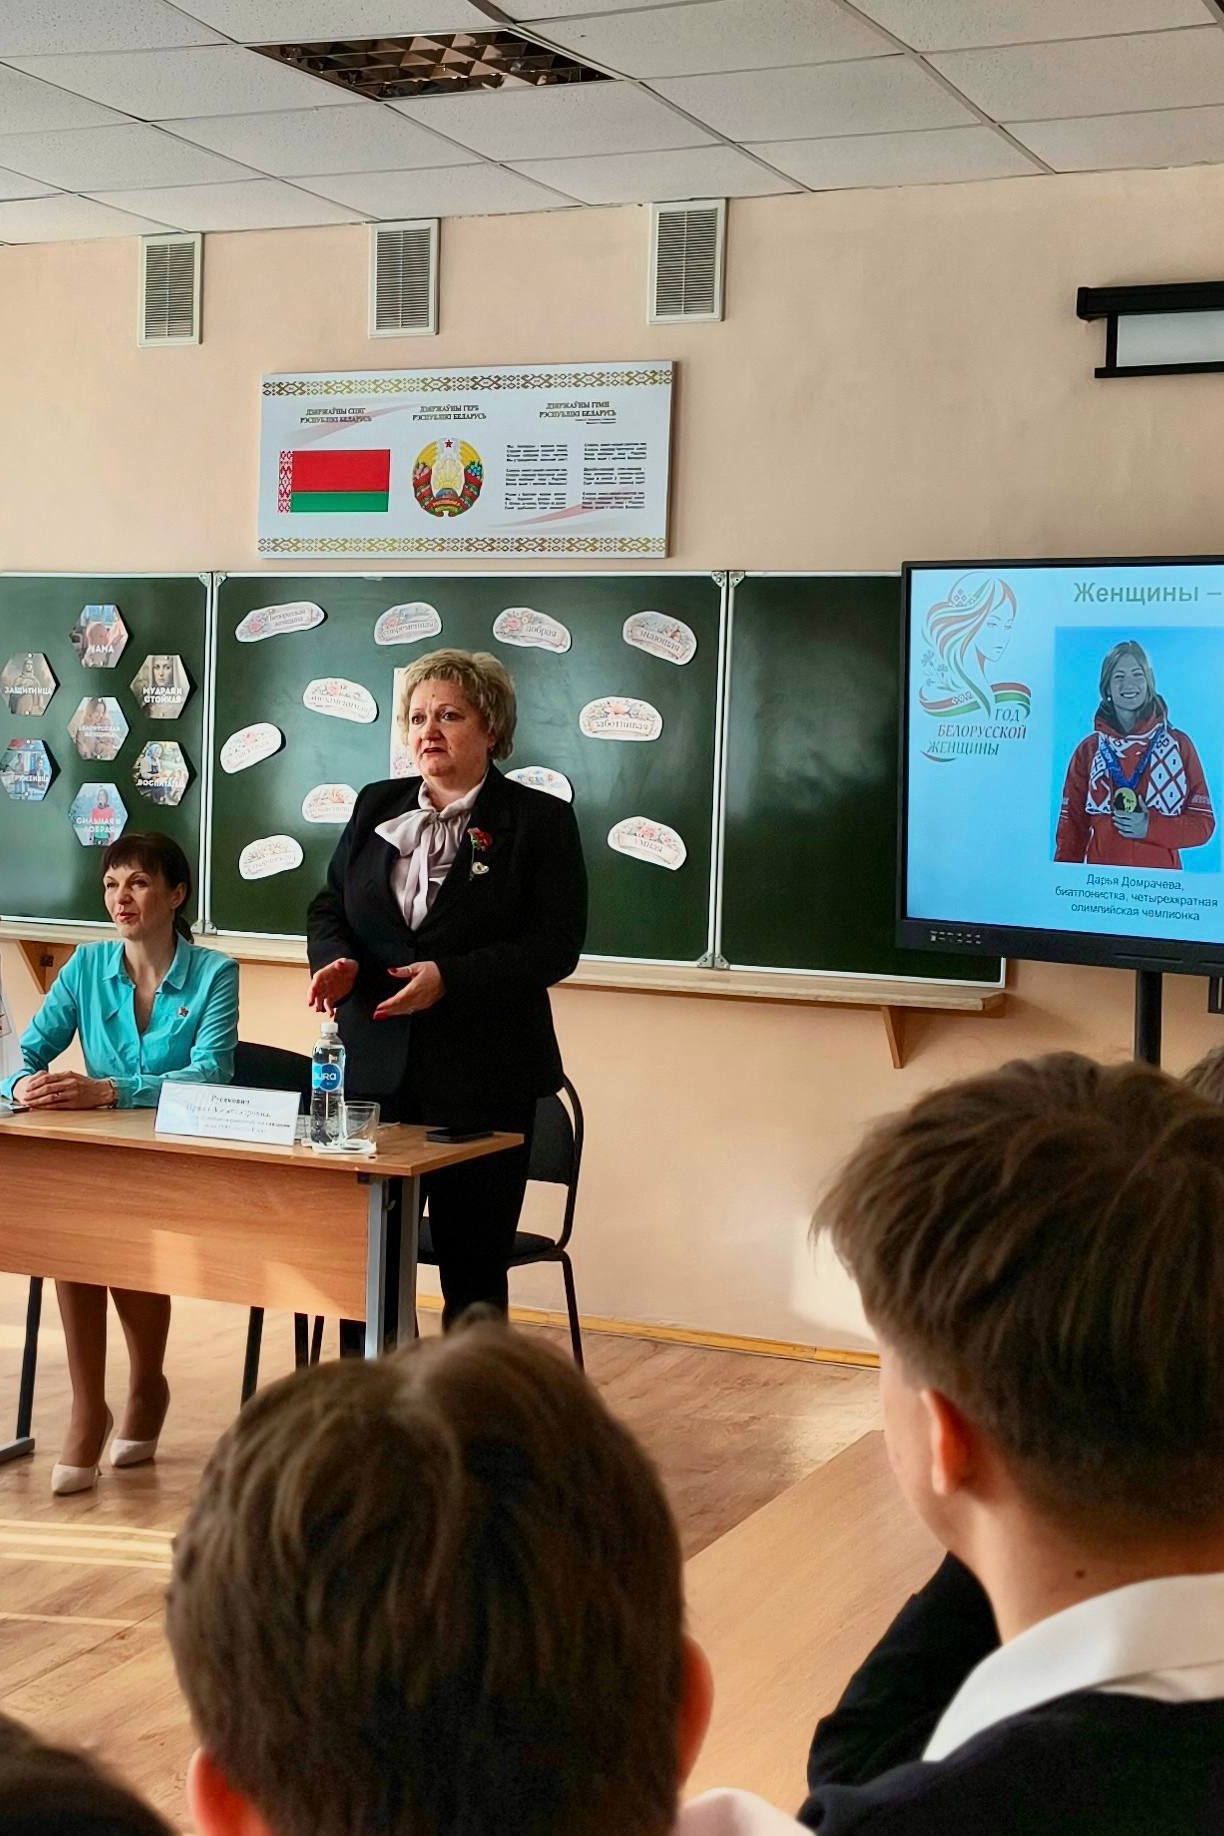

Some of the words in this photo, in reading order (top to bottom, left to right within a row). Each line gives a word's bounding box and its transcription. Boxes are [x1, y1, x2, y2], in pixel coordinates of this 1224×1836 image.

[1073, 581, 1199, 606] Женщины
[995, 707, 1020, 722] ГОД
[937, 723, 1027, 740] БЕЛОРУССКОЙ
[927, 741, 1000, 757] ЖЕНЩИНЫ
[1086, 873, 1119, 886] Дарья
[1121, 876, 1184, 891] Домрачева,
[1055, 885, 1128, 902] биатлонистка,
[1130, 893, 1218, 908] четырехкратная
[1071, 903, 1139, 917] олимпийская
[1142, 909, 1200, 921] чемпионка
